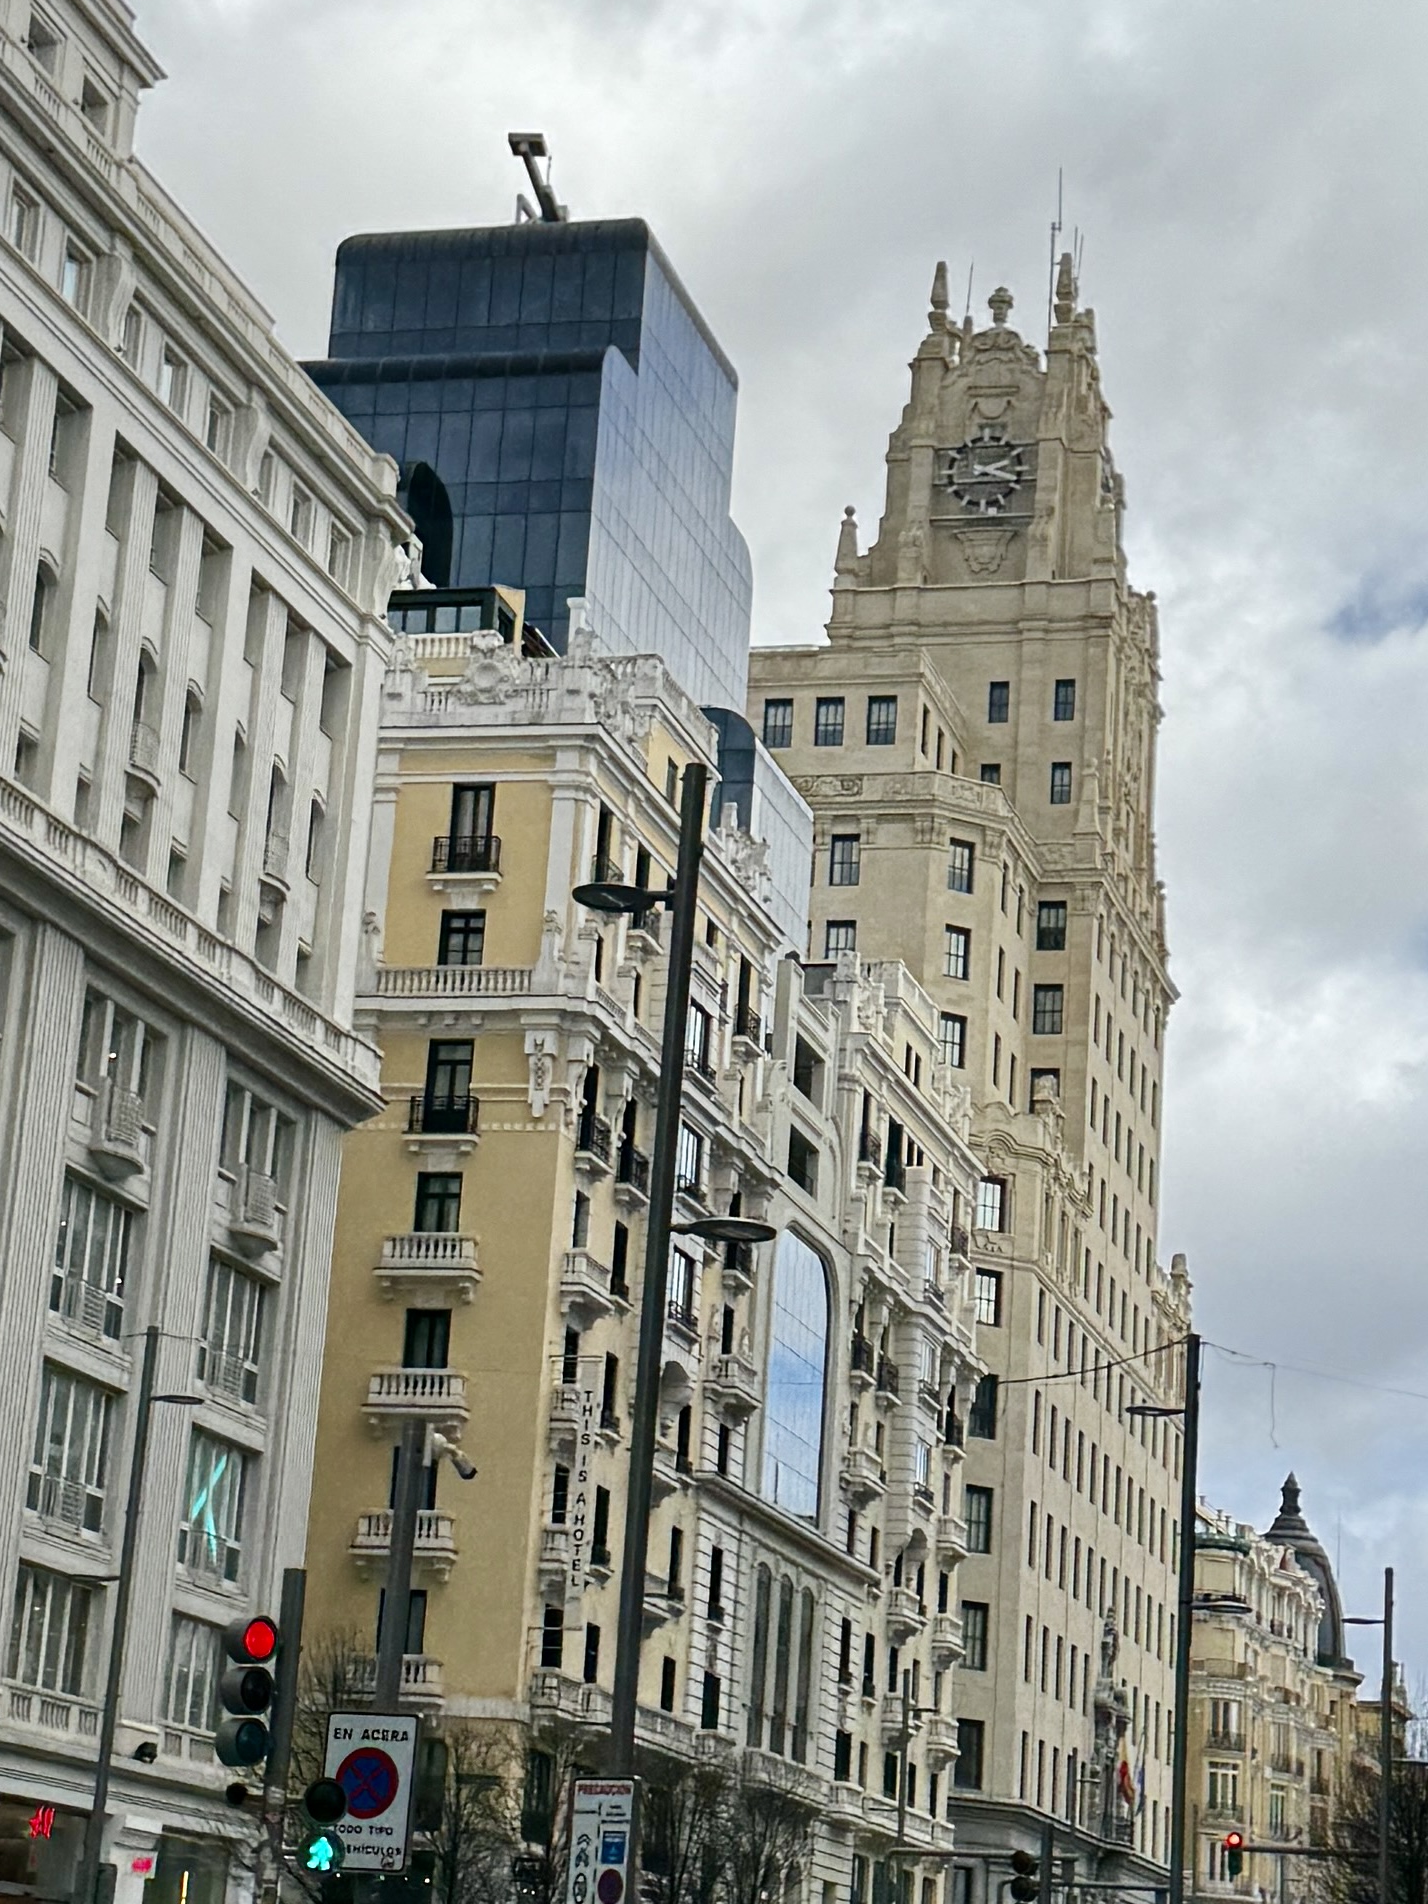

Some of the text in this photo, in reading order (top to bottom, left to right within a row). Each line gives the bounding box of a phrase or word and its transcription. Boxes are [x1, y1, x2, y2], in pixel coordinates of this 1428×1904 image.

[570, 1390, 593, 1587] THIS IS A HOTEL
[334, 1727, 409, 1743] EN ACERA
[346, 1843, 403, 1857] EHÍCULOS
